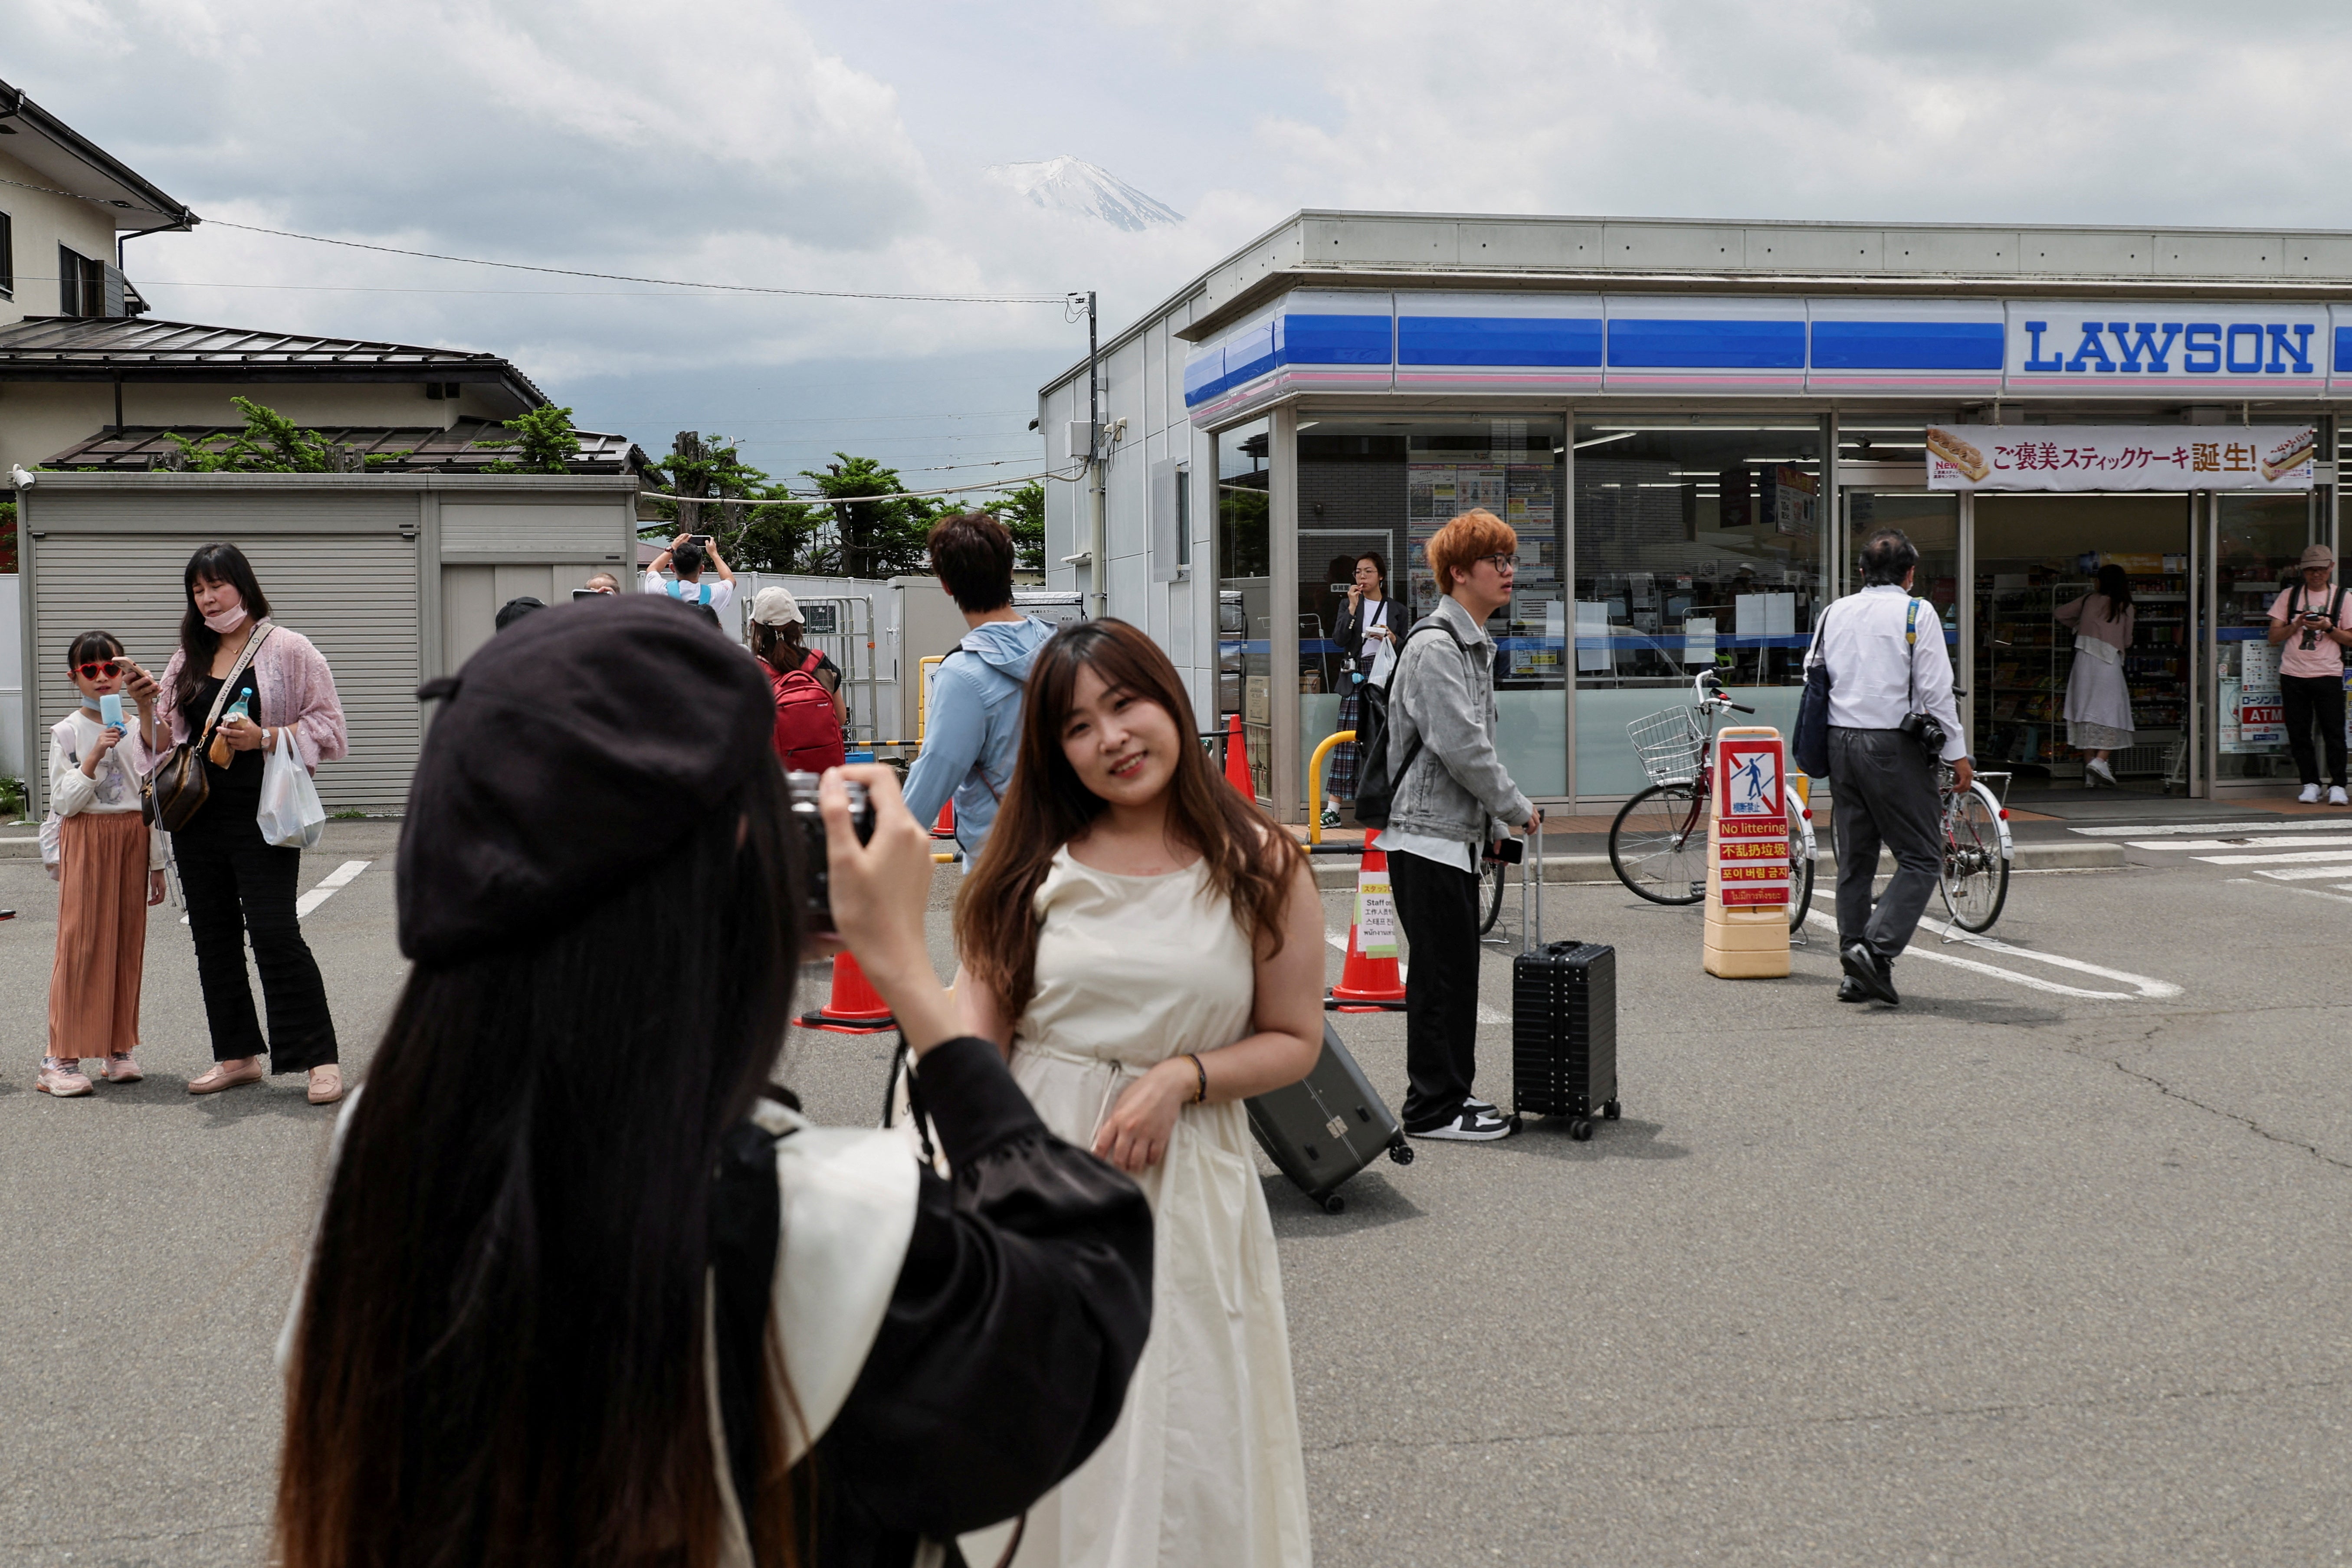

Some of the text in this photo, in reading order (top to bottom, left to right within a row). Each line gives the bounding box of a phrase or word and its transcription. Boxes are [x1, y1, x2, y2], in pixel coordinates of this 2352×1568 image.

[2024, 321, 2315, 374] LAWSON
[1994, 442, 2257, 472] ご褒美スティックケーキ誕生!
[1936, 461, 1959, 469] New
[1908, 606, 1916, 624] Nikon
[2242, 695, 2281, 704] ローソン銀
[2250, 709, 2283, 721] ATM
[1733, 802, 1760, 813] 横断禁止
[1722, 823, 1786, 835] No littering
[1722, 843, 1786, 857] 不乱扔垃圾
[1722, 867, 1788, 879] 포이 버림 금지
